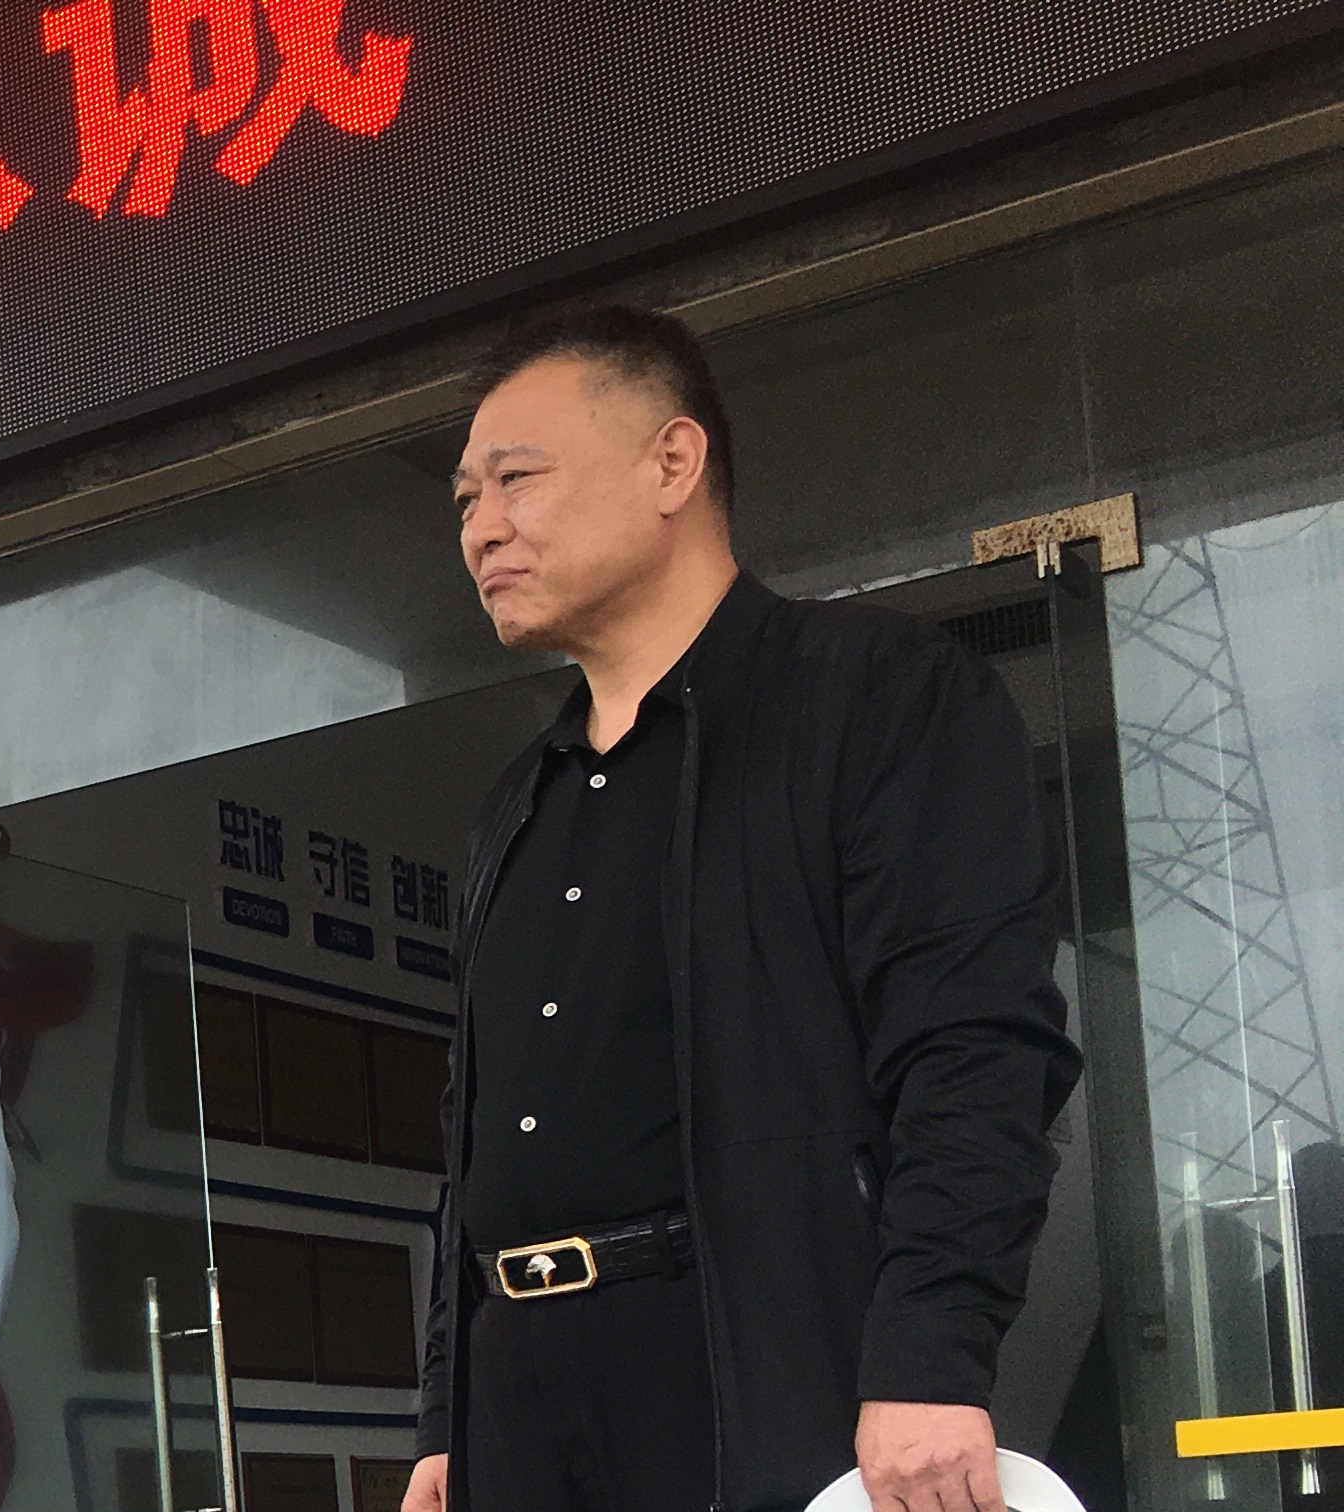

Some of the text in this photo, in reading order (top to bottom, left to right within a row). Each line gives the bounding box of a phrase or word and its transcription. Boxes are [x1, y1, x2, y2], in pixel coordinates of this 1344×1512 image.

[218, 799, 448, 930] 忠诚 守信 创新
[232, 900, 282, 925] DEVOTION
[331, 926, 357, 947] FAITH
